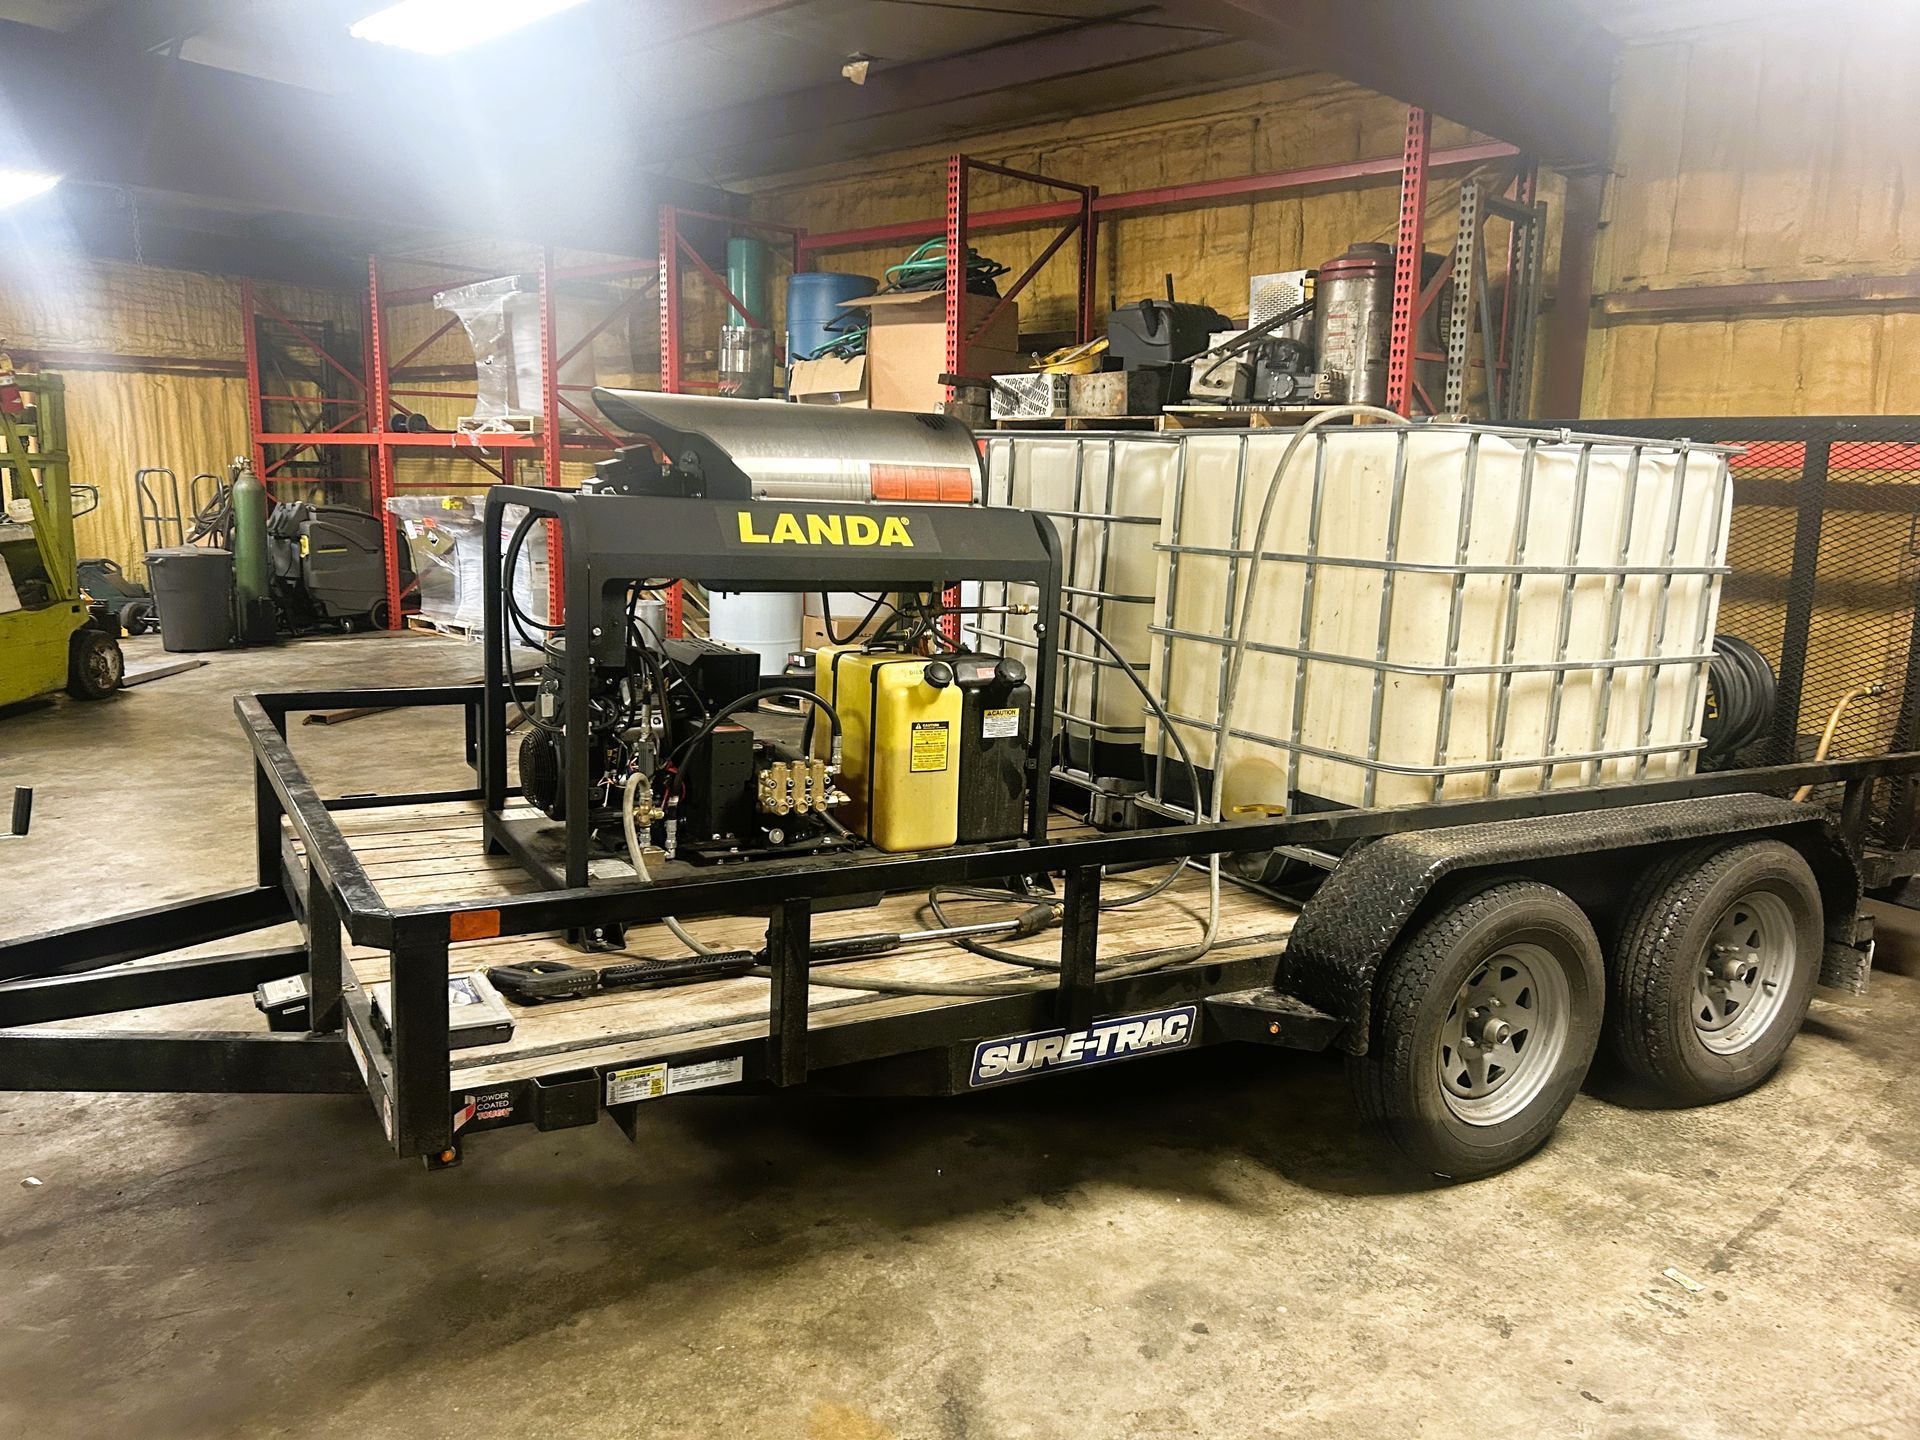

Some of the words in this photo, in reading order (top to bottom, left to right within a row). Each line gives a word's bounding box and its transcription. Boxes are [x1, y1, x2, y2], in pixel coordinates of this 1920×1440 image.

[1029, 402, 1046, 415] WIPES
[979, 1015, 1189, 1078] SURE-TRAC
[477, 1092, 509, 1102] POWDER
[477, 1100, 509, 1110] COATED
